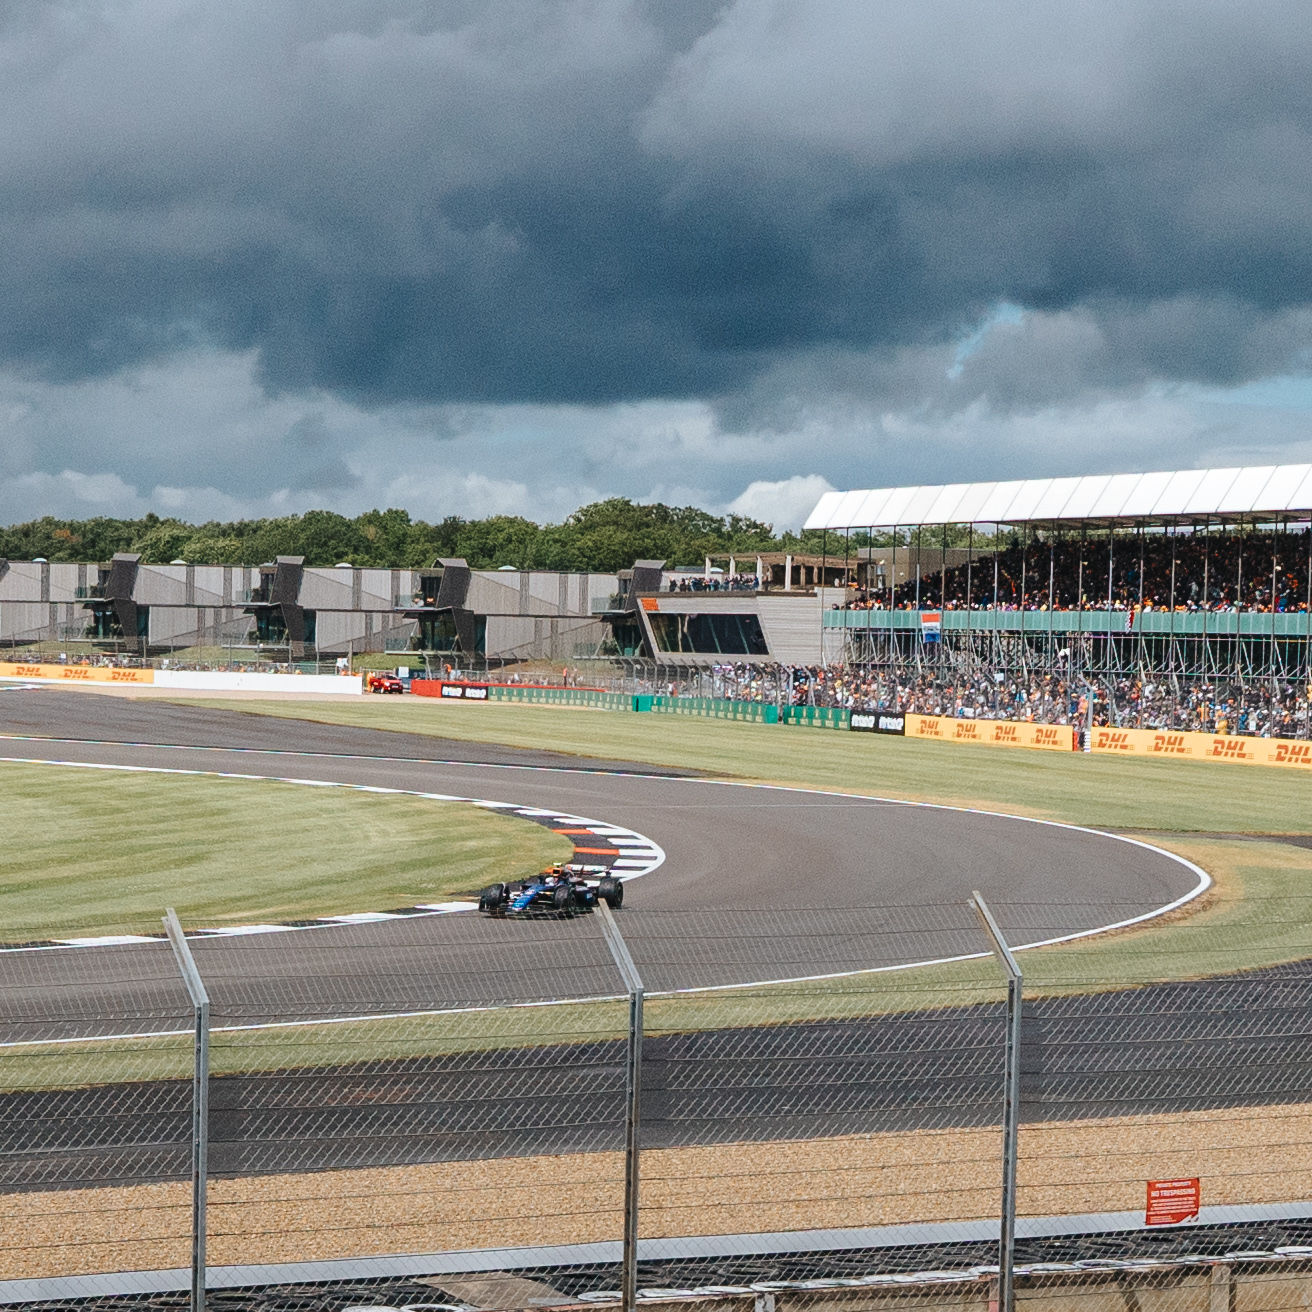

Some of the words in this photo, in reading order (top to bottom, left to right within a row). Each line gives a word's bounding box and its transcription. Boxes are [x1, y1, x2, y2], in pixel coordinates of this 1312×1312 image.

[16, 666, 41, 676] DHL
[64, 669, 89, 678] DHL
[111, 671, 138, 681] DHL
[1098, 733, 1129, 749] DHL
[1154, 736, 1187, 753] DHL
[1213, 740, 1248, 758] DHL
[1276, 745, 1312, 764] DHL
